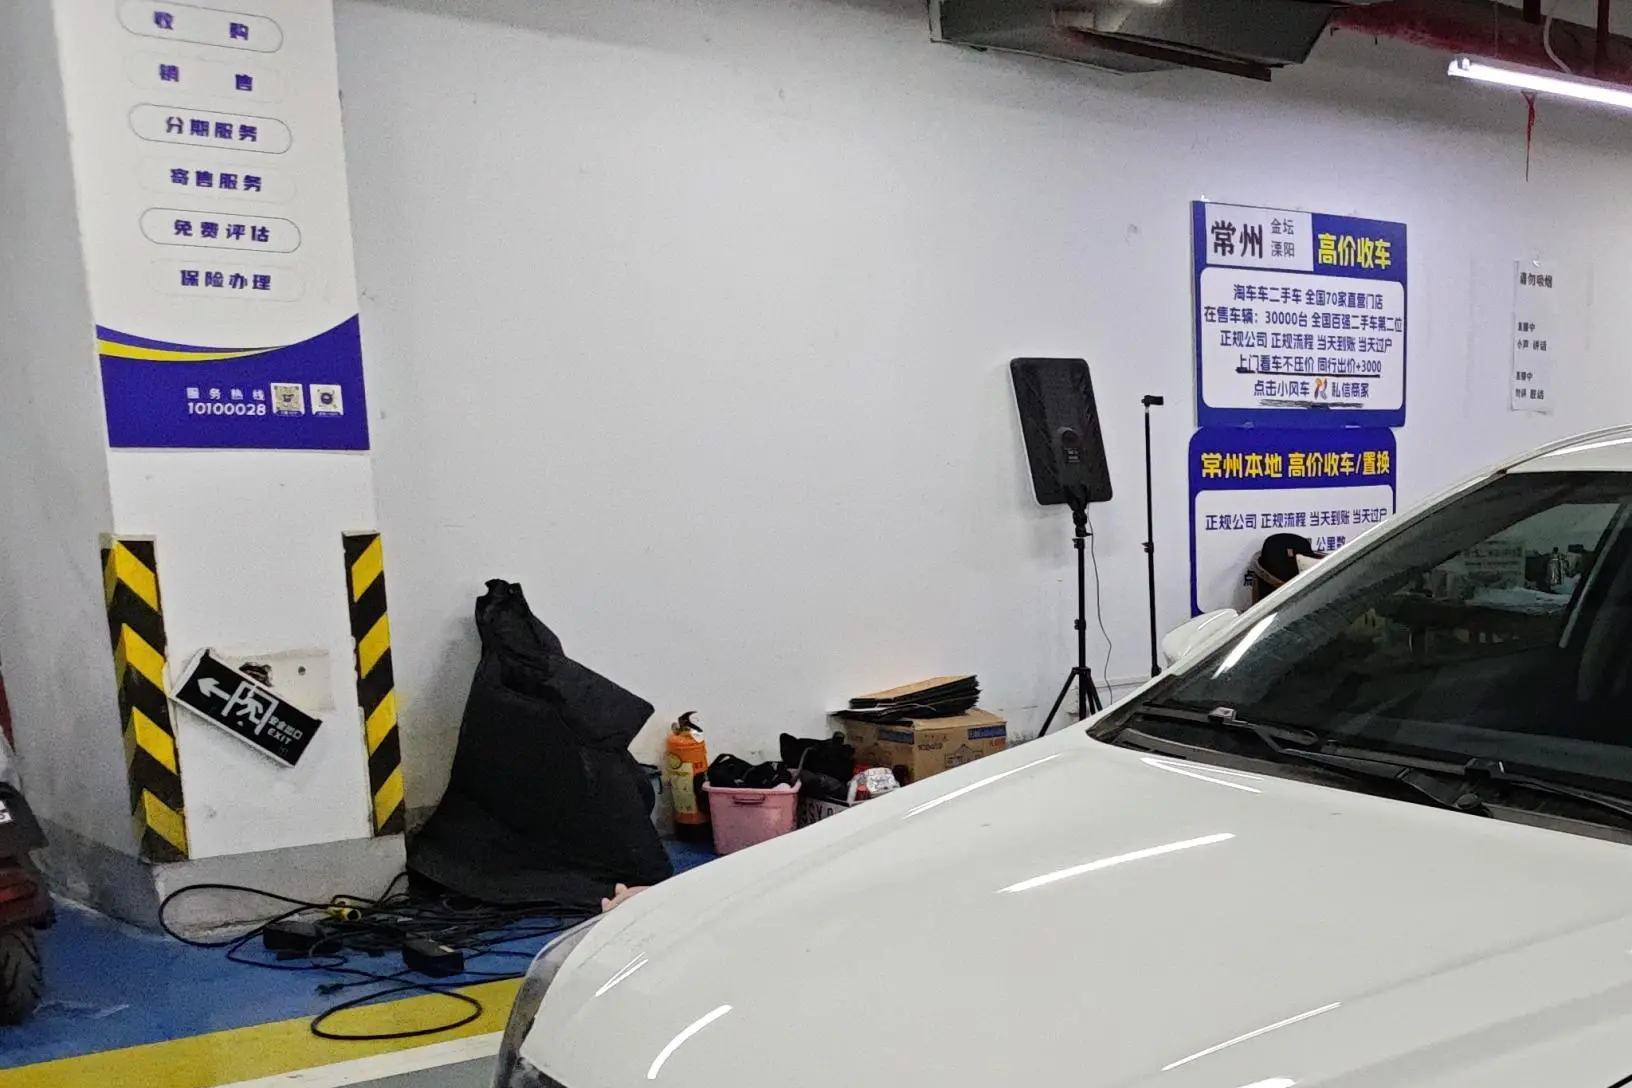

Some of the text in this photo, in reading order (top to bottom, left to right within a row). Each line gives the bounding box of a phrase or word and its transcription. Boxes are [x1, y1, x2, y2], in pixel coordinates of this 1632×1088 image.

[166, 117, 258, 142] 分期服务
[170, 169, 262, 192] 寄售服务
[174, 221, 270, 242] 免费评估
[1271, 218, 1294, 235] 金坛
[1211, 220, 1263, 259] 常州
[1318, 233, 1392, 269] 高价收车
[180, 269, 272, 291] 保险办理
[1233, 284, 1302, 304] 淘车车二手车
[1220, 330, 1393, 353] 正规公司 正规流程 当天到账 当天过户
[1317, 357, 1382, 373] 同行出价+3000
[1254, 380, 1310, 397] 点击小风车
[187, 402, 266, 416] 10100028
[1201, 450, 1390, 478] 常州本地 高价收车/置换
[1205, 508, 1388, 531] 正规公司 正规流程 当天到账 当天过户
[267, 727, 292, 745] EXIT
